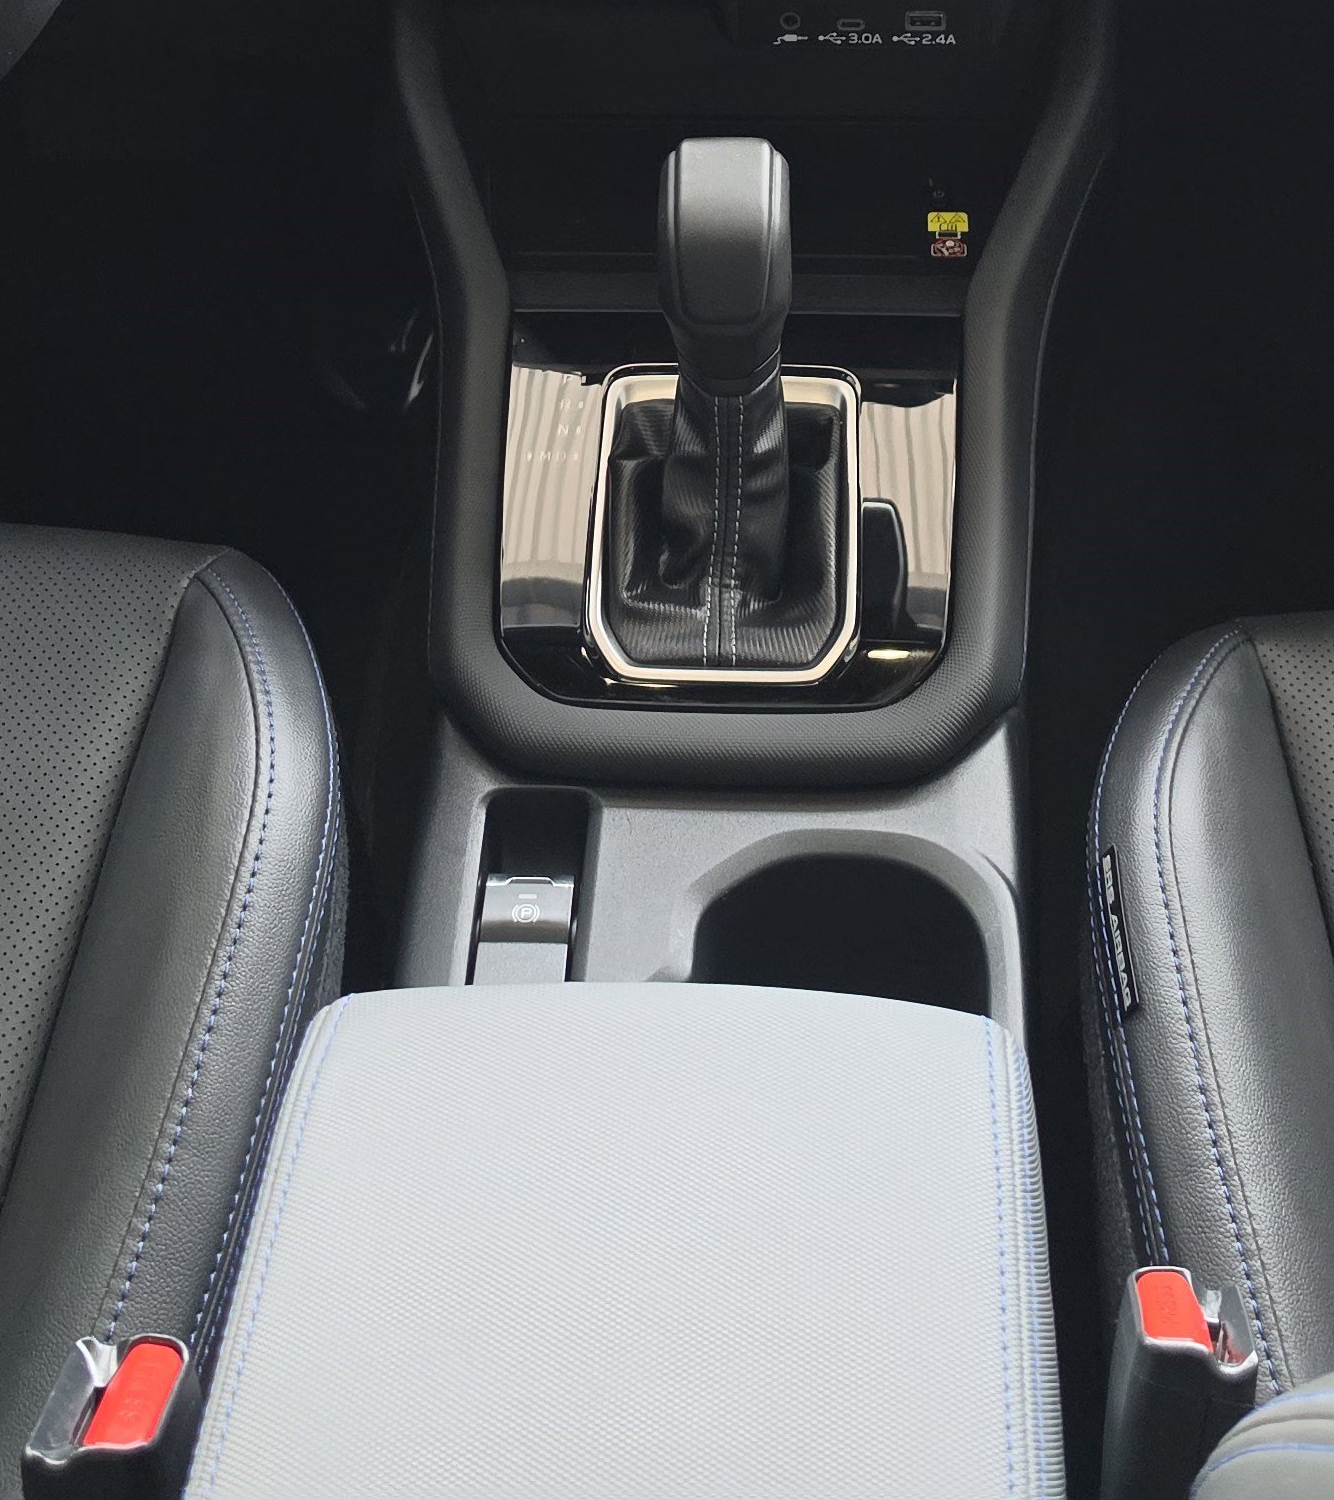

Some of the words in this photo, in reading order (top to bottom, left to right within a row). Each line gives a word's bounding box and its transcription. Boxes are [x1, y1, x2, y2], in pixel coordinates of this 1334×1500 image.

[848, 33, 883, 45] 3.0A
[921, 33, 957, 45] 2.4A
[557, 424, 569, 435] N
